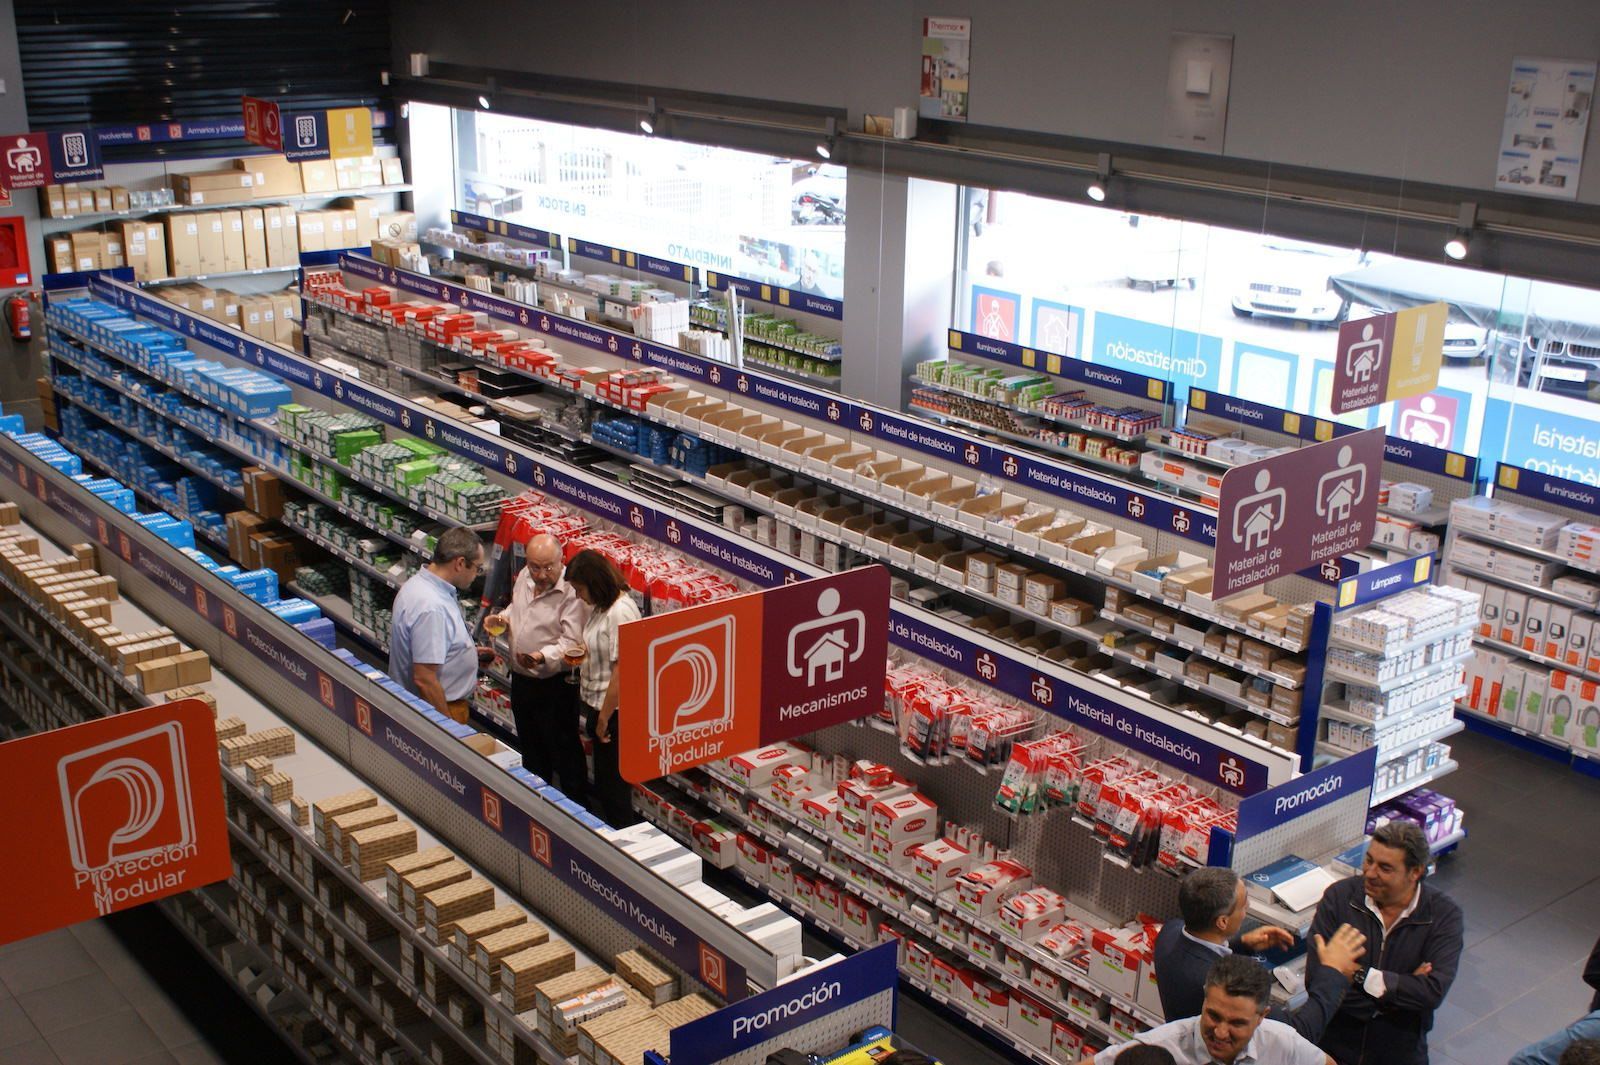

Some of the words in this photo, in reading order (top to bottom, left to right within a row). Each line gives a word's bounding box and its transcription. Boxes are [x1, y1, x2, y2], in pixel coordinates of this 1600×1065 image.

[930, 21, 959, 31] Thermor
[187, 125, 215, 134] Armarios
[287, 149, 329, 158] Comunicaciones
[10, 172, 31, 181] Material
[12, 179, 45, 188] Instalación
[54, 168, 103, 179] Comunicaciones
[648, 261, 671, 274] Iluminación
[806, 299, 835, 313] Iluminación
[555, 323, 571, 334] Material
[578, 330, 603, 344] instalación
[976, 342, 1007, 356] Iluminación
[648, 351, 669, 365] Material
[676, 360, 704, 376] instalación
[1084, 368, 1123, 386] Iluminación
[347, 389, 366, 405] Material
[372, 400, 396, 418] instalación
[755, 384, 778, 398] Material
[779, 391, 788, 402] de
[788, 393, 820, 412] instalación
[1341, 393, 1377, 410] Instalación
[1342, 383, 1369, 399] Material
[1369, 382, 1379, 393] de
[1225, 402, 1264, 420] Iluminación
[441, 429, 462, 447] Material
[469, 442, 499, 462] instalación
[881, 422, 907, 439] Material
[908, 430, 918, 442] de
[918, 433, 956, 454] instalación
[552, 477, 577, 497] Material
[586, 492, 622, 516] instalación
[1028, 467, 1060, 486] Material
[1060, 477, 1072, 490] de
[1072, 480, 1117, 506] instalación
[1543, 483, 1595, 505] Iluminación
[1311, 526, 1348, 545] Material
[1349, 519, 1361, 532] de
[690, 534, 719, 557] Material
[720, 547, 732, 561] de
[731, 552, 774, 581] instalación
[1228, 553, 1270, 574] Material
[1270, 546, 1282, 560] de
[1310, 536, 1359, 561] Instalación
[232, 569, 270, 580] simon
[1227, 562, 1280, 590] Instalación
[1371, 573, 1402, 591] Lámparas
[246, 628, 280, 662] Protección
[279, 651, 308, 681] Modular
[896, 623, 909, 638] de
[911, 627, 963, 662] instalación
[779, 685, 868, 721] Mecanismos
[648, 718, 734, 753] Protección
[1068, 695, 1114, 728] Material
[1116, 714, 1133, 735] de
[1135, 720, 1201, 765] instalación
[386, 727, 430, 770] Protección
[430, 758, 467, 796] Modular
[659, 739, 724, 769] Modular
[1274, 774, 1343, 815] Promoción
[74, 842, 198, 889] Protección
[93, 868, 187, 909] Modular
[570, 859, 628, 914] Protección
[629, 901, 678, 949] Modular
[732, 981, 841, 1039] Promoción
